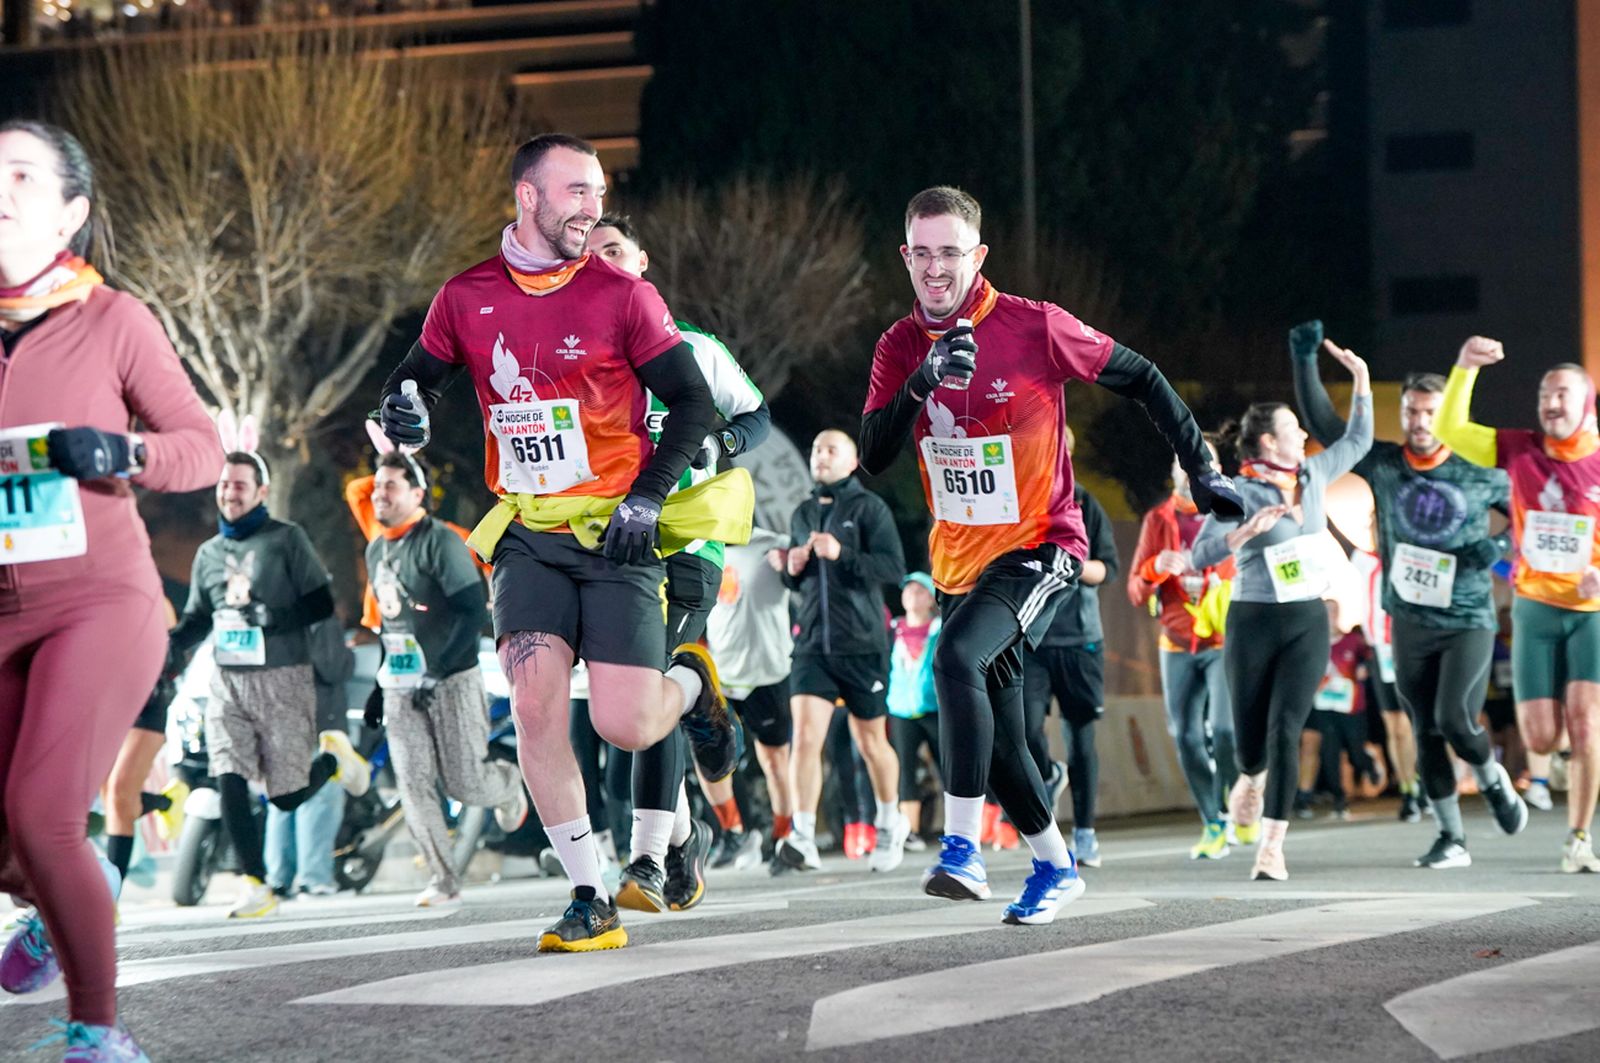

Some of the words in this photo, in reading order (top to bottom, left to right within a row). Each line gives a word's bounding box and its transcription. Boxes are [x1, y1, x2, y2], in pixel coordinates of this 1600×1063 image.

[505, 413, 532, 424] NOCHE
[532, 411, 544, 422] DE
[516, 421, 546, 434] ANTÓN
[510, 433, 565, 464] 6511
[940, 447, 962, 458] NOCHE
[964, 448, 975, 457] DE
[934, 456, 949, 466] SAN
[943, 468, 996, 496] 6510
[1536, 533, 1580, 554] 5653
[1404, 566, 1439, 589] 2421
